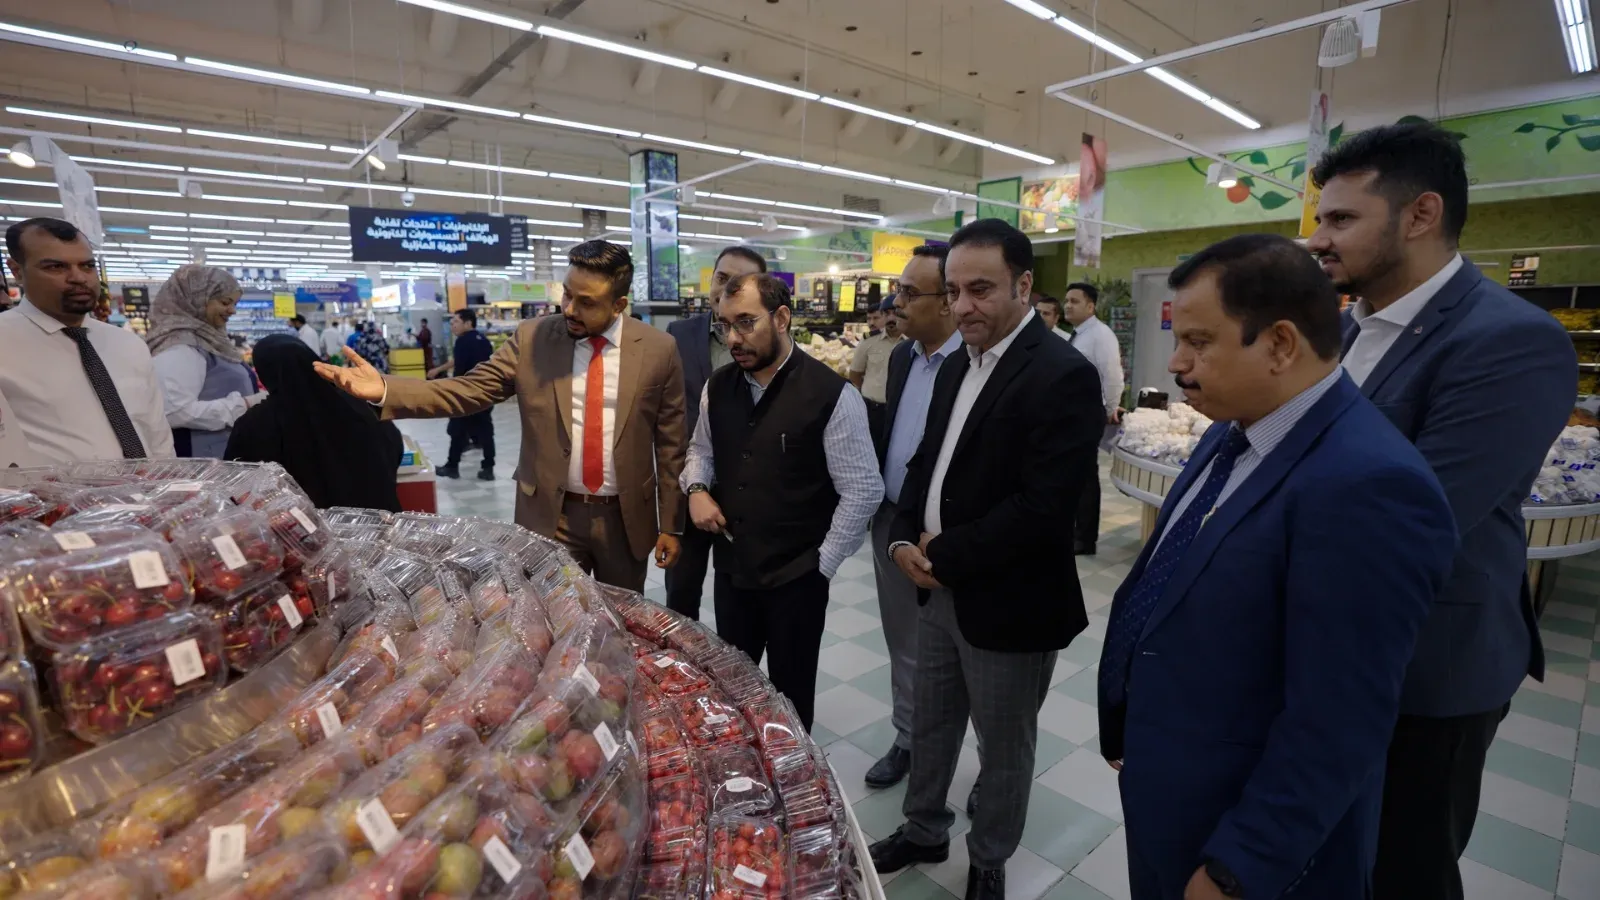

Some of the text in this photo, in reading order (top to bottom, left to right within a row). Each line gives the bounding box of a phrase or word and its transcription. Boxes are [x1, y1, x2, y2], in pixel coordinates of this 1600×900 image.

[374, 216, 401, 228] تقنية
[402, 218, 436, 229] منتجات
[401, 239, 436, 251] المنزلية
[466, 233, 499, 245] الهواتف
